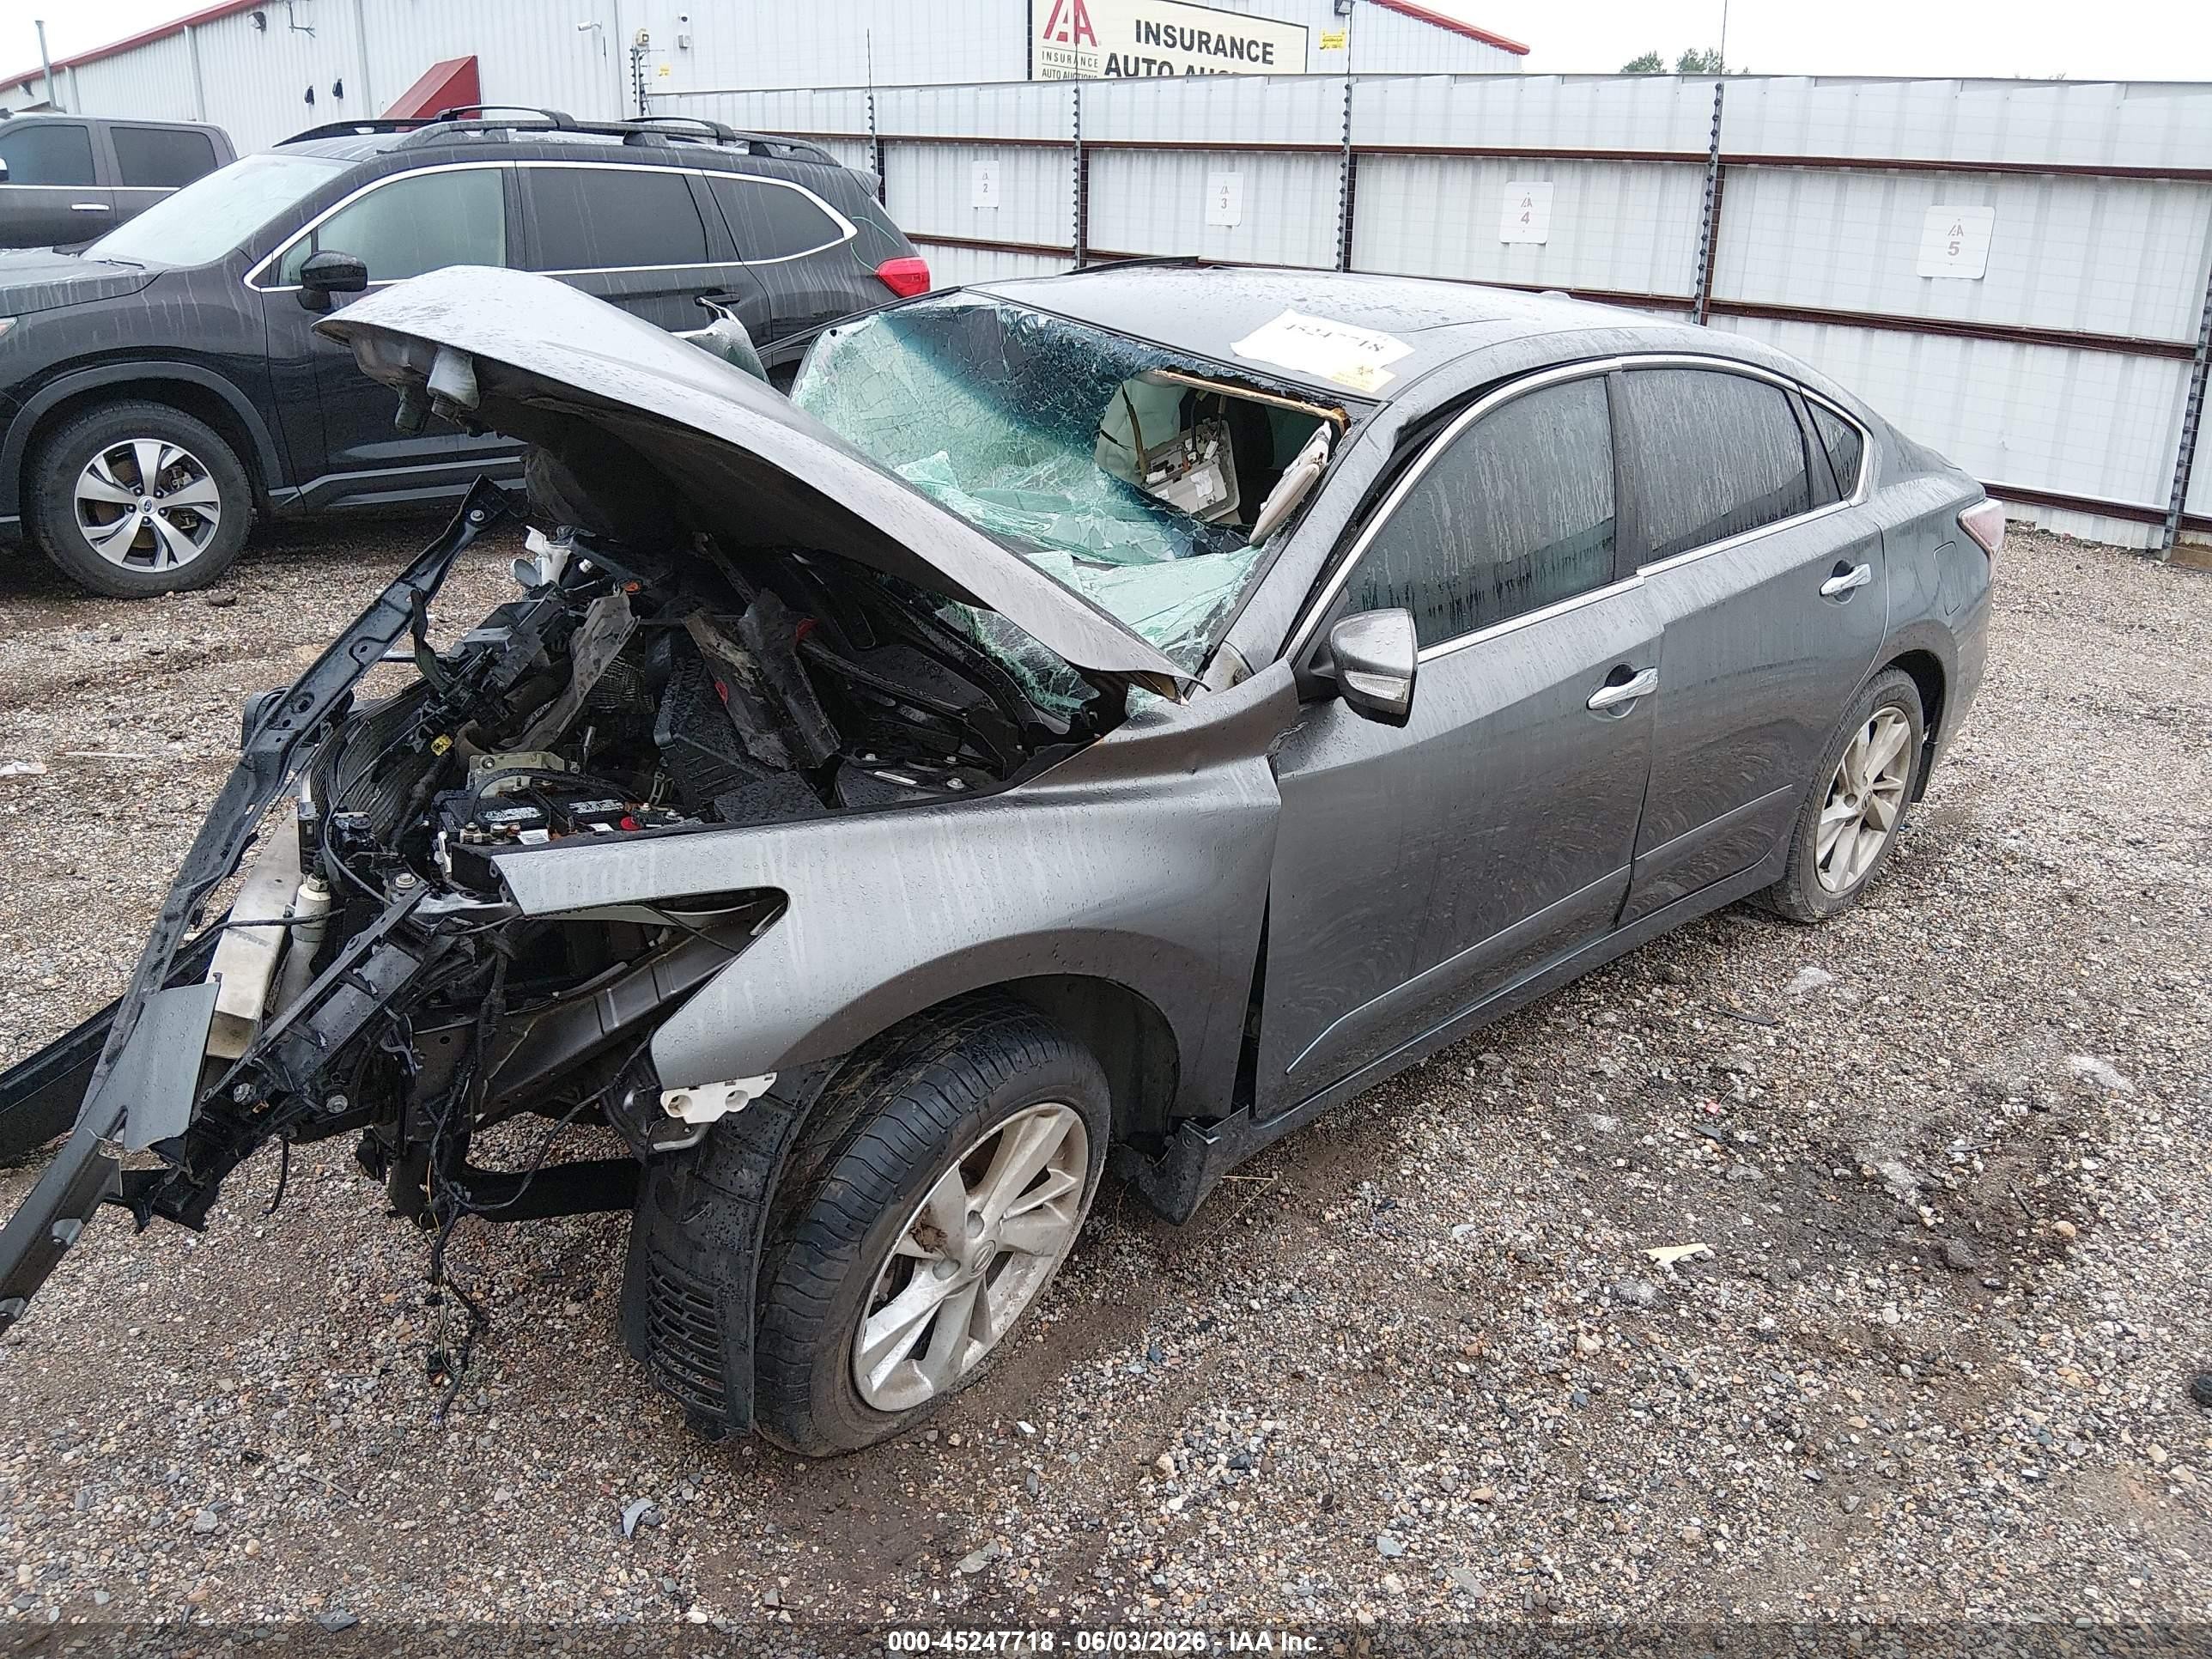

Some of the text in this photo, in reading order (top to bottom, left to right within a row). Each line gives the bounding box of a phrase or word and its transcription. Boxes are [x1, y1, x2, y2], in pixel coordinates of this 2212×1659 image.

[1135, 19, 1274, 65] INSURANCE
[1042, 51, 1098, 68] INSURANCE
[1104, 52, 1175, 77] AUTO
[1042, 68, 1061, 80] AUTO
[982, 183, 988, 193] 2
[1221, 198, 1228, 209] 3
[1521, 211, 1530, 224] 4
[1948, 240, 1960, 256] 5
